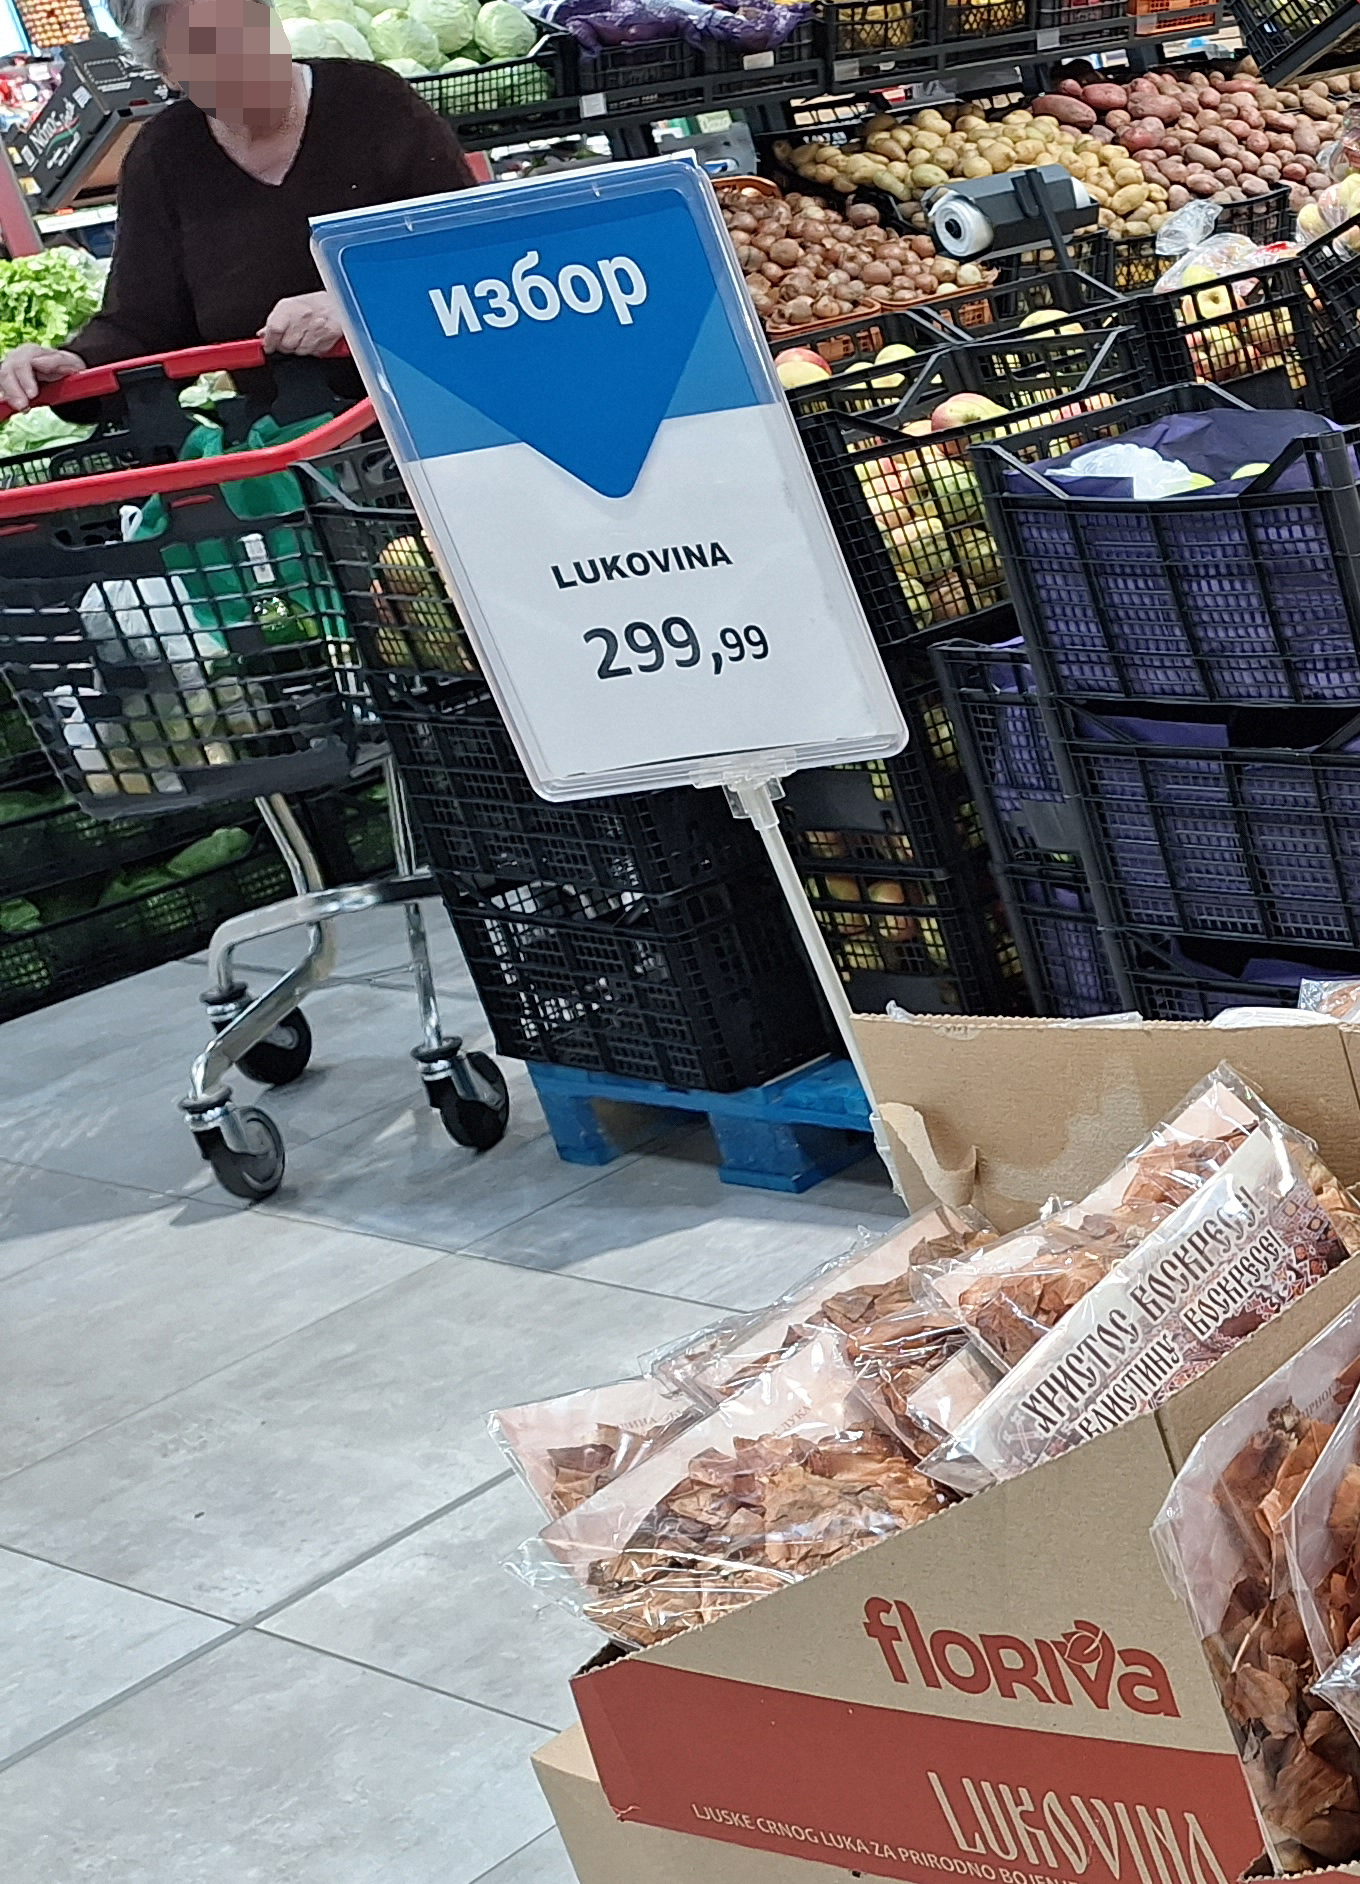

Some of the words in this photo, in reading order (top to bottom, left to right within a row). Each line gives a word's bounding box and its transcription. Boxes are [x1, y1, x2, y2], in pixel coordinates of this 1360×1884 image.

[428, 250, 648, 337] избор
[551, 541, 733, 589] LUKOVINA
[583, 616, 769, 680] 299,99
[1183, 1229, 1286, 1337] ВОСКРЕСЕ!
[1022, 1309, 1140, 1434] ХРИСТОС
[692, 1802, 756, 1830] LJUSKE
[757, 1817, 819, 1844] CRNOG
[821, 1830, 870, 1855] LUKA
[871, 1841, 898, 1861] ZA
[898, 1847, 997, 1880] PRIRODNO
[999, 1867, 1079, 1884] BOJE
[926, 1770, 1230, 1884] LUKOVINA
